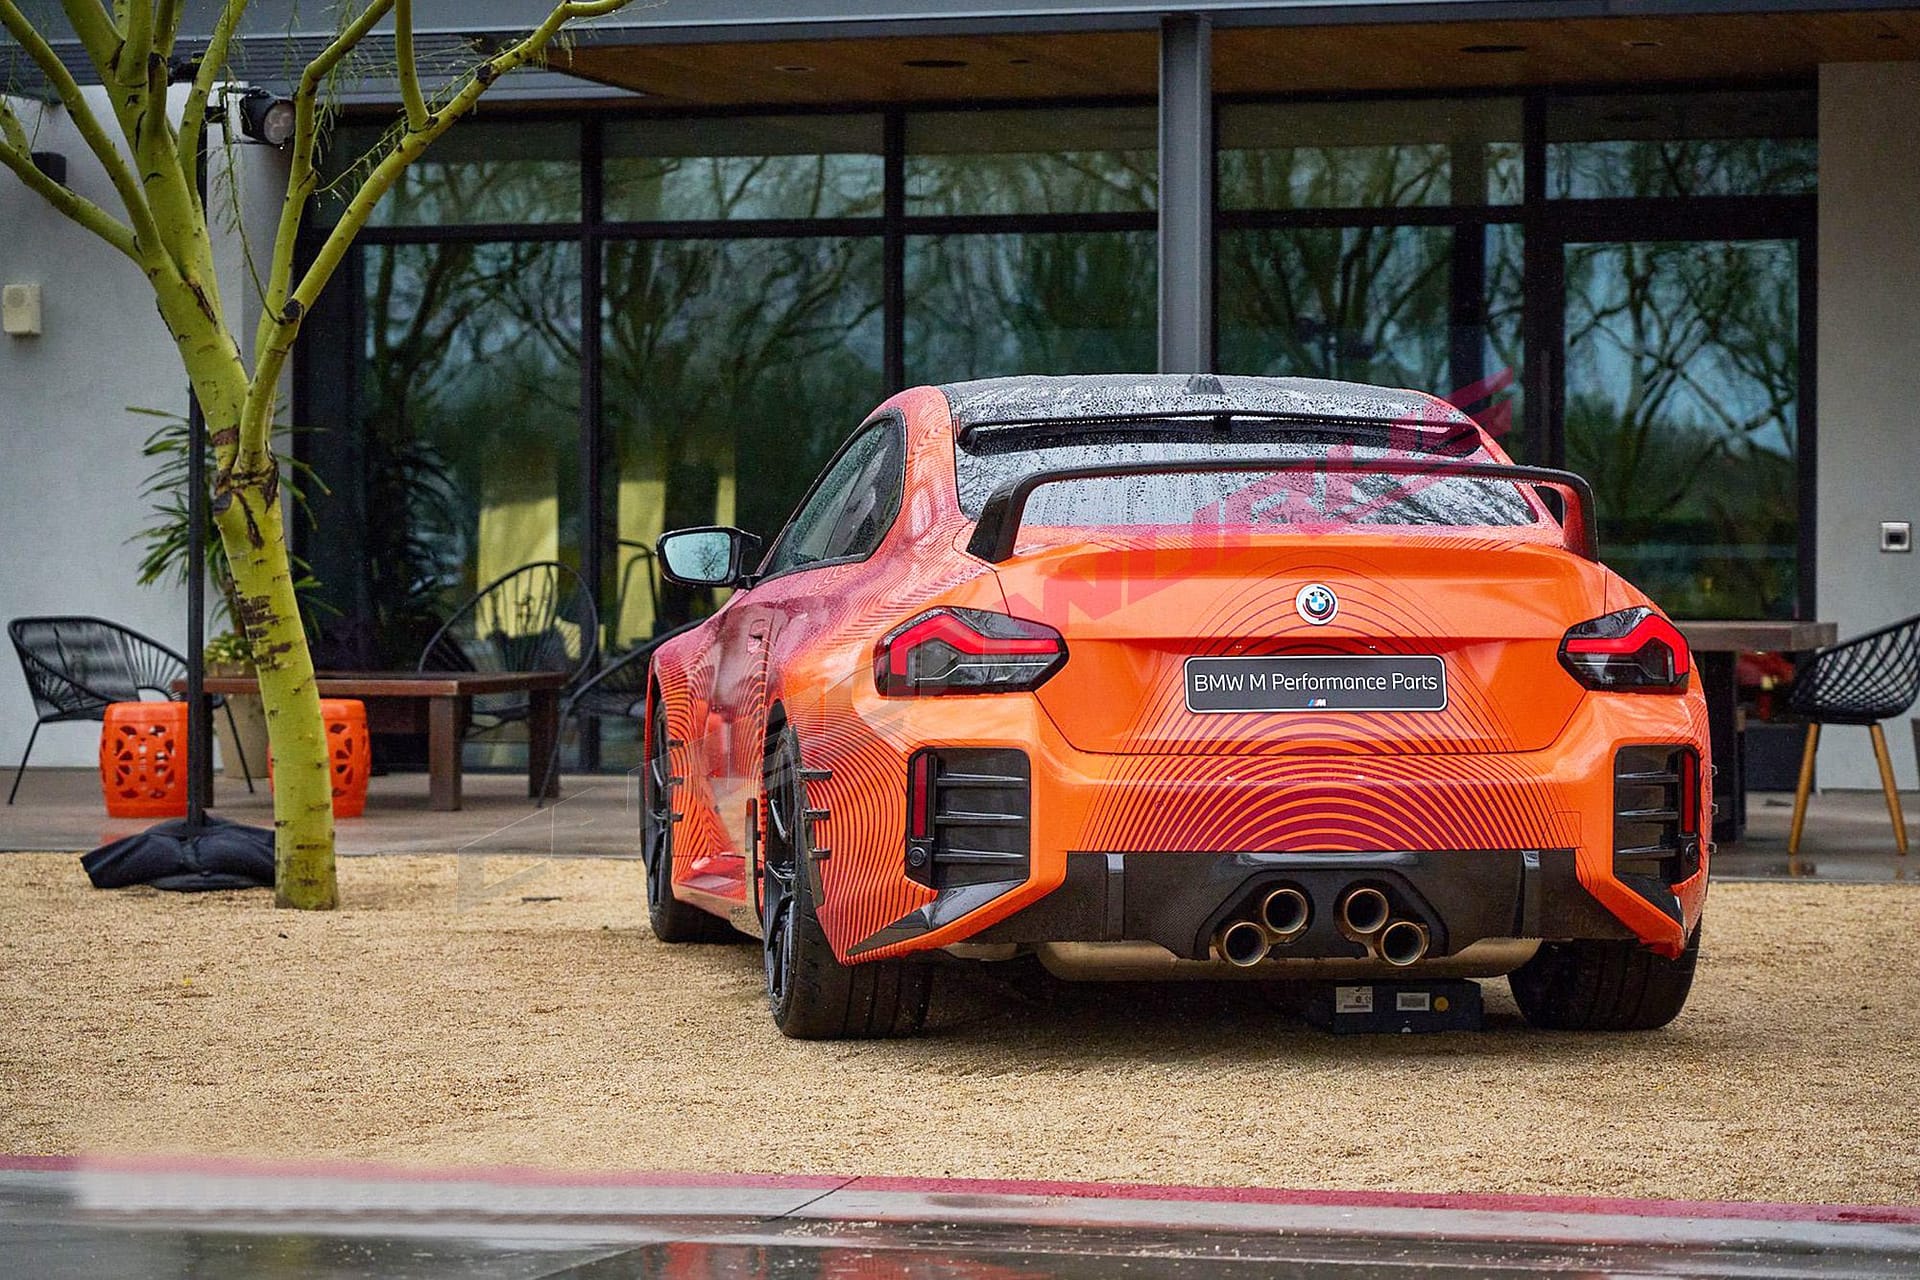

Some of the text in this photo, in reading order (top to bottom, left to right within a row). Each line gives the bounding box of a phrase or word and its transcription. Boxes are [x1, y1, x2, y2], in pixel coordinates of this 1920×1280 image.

[1194, 672, 1438, 692] BMW M Performance Parts
